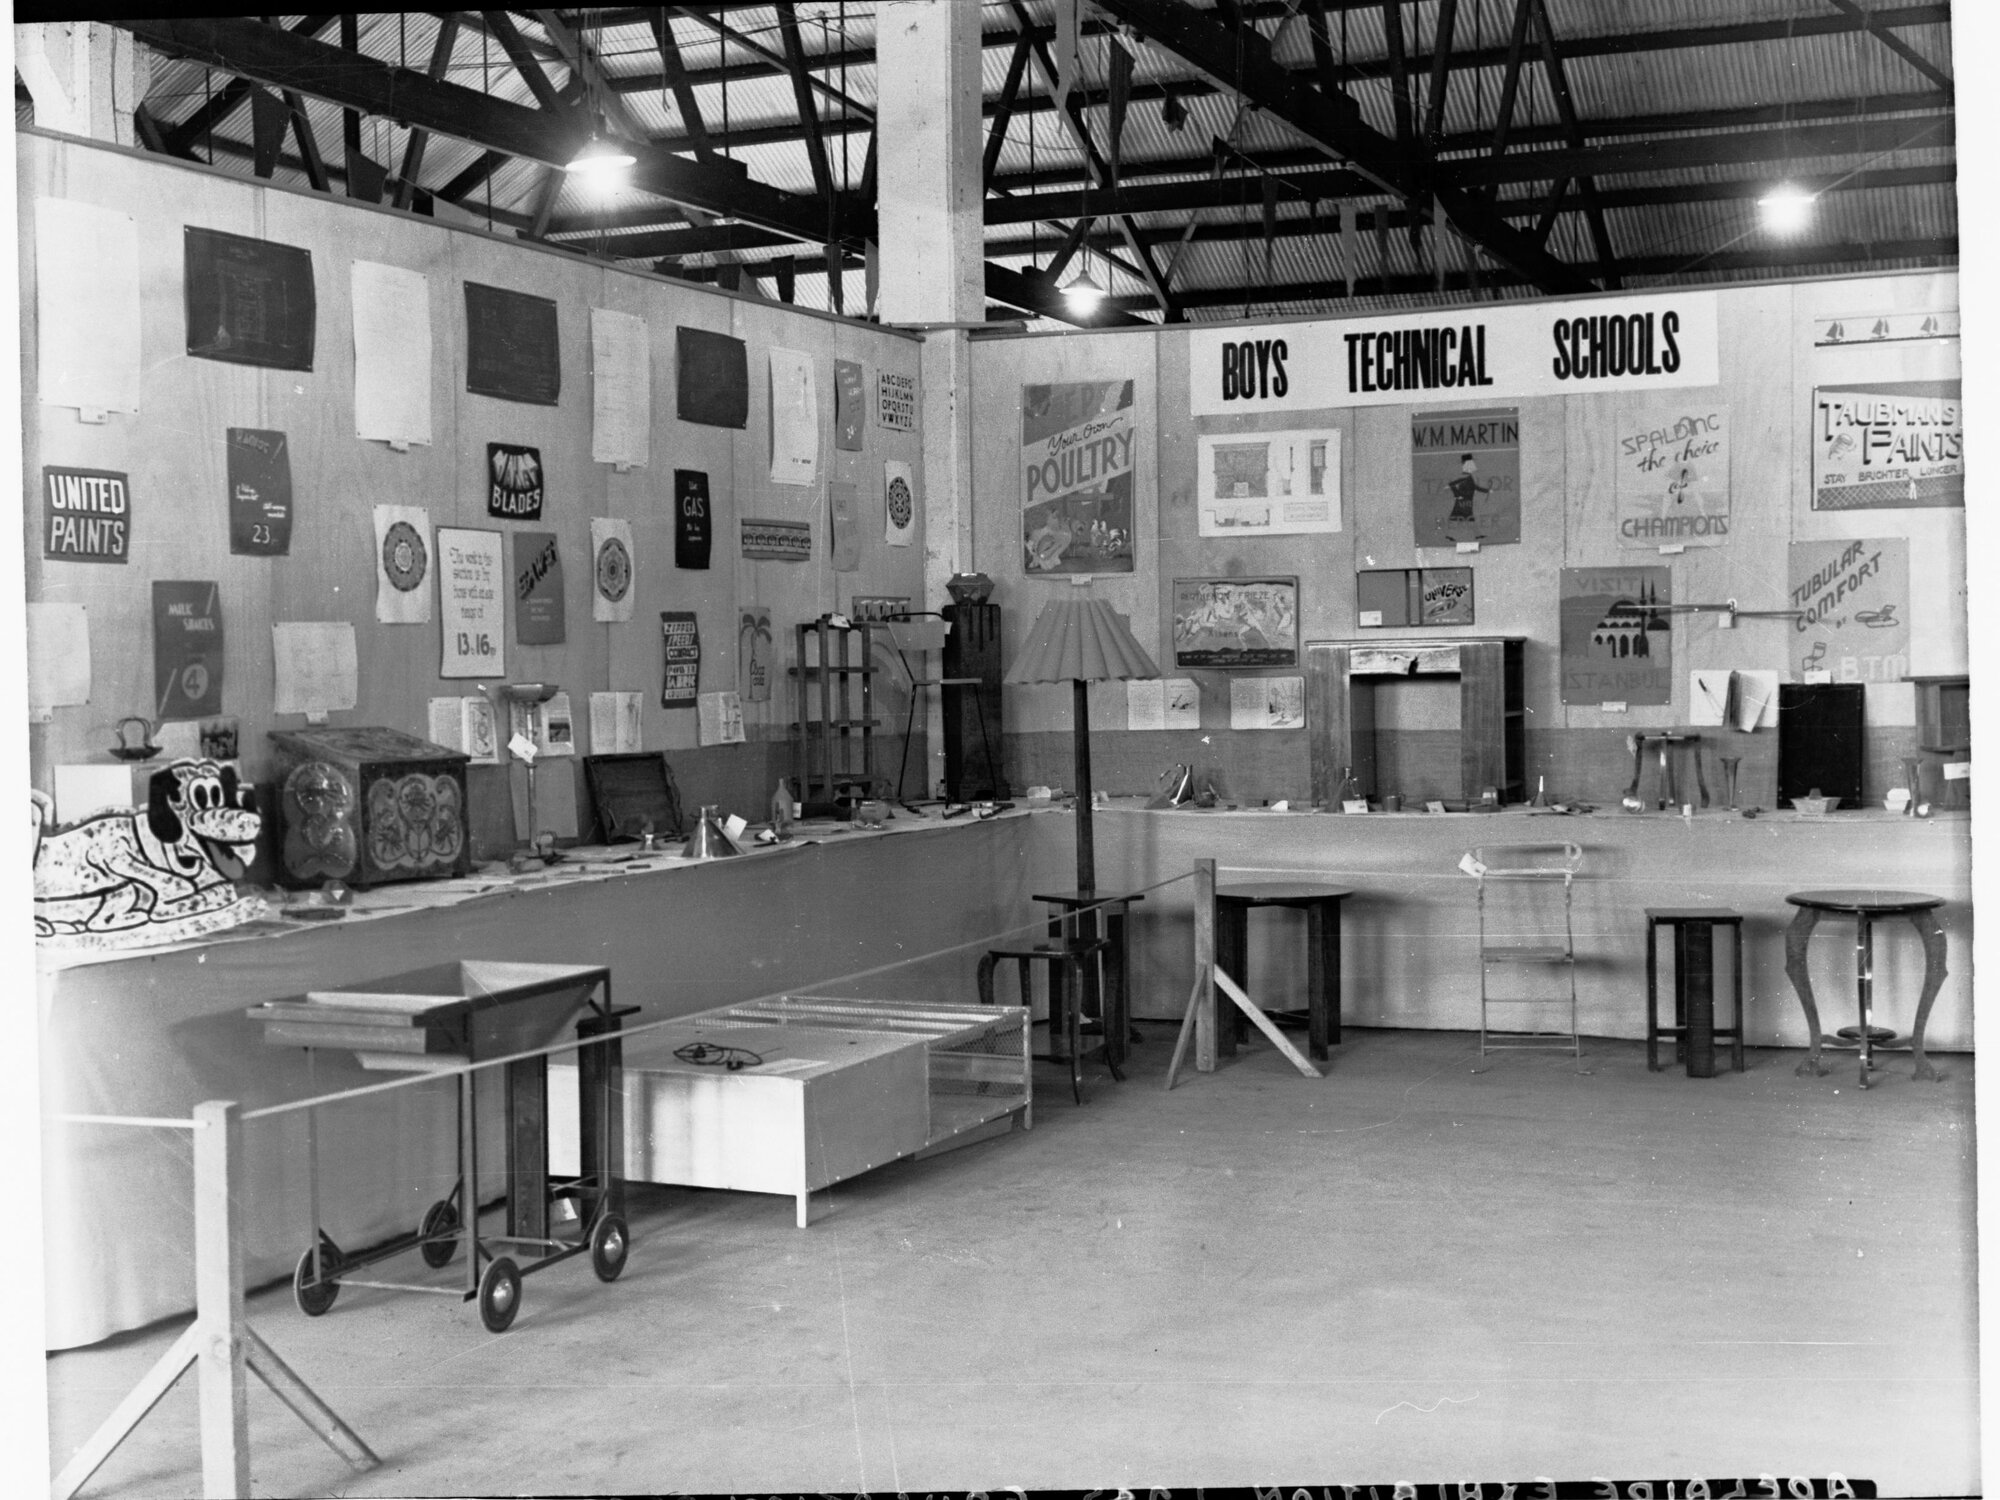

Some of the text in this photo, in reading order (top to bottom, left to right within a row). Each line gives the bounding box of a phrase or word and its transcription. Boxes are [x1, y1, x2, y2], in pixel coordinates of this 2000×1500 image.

[1222, 310, 1681, 401] BOYS TECHNICAL SCHOOLS
[1047, 416, 1124, 457] Your Own
[1450, 421, 1519, 446] MARTIN
[1819, 400, 1956, 442] TAUBMANS
[1637, 438, 1720, 472] the choice
[1862, 425, 1962, 465] PAINTS
[1026, 426, 1134, 502] POULTRY
[1823, 473, 1847, 484] STAY
[49, 474, 125, 514] UNITED
[492, 484, 541, 514] BLADES
[1668, 468, 1689, 505] of
[683, 496, 704, 517] GAS
[50, 516, 124, 555] PAINTS
[252, 524, 270, 543] 23
[1621, 514, 1729, 538] CHAMPIONS
[1576, 577, 1640, 593] VISIT
[1791, 540, 1866, 609] TUBULAR
[1796, 551, 1882, 632] COMFORT
[168, 602, 193, 616] MILK
[457, 632, 470, 656] 13
[476, 633, 490, 656] 16
